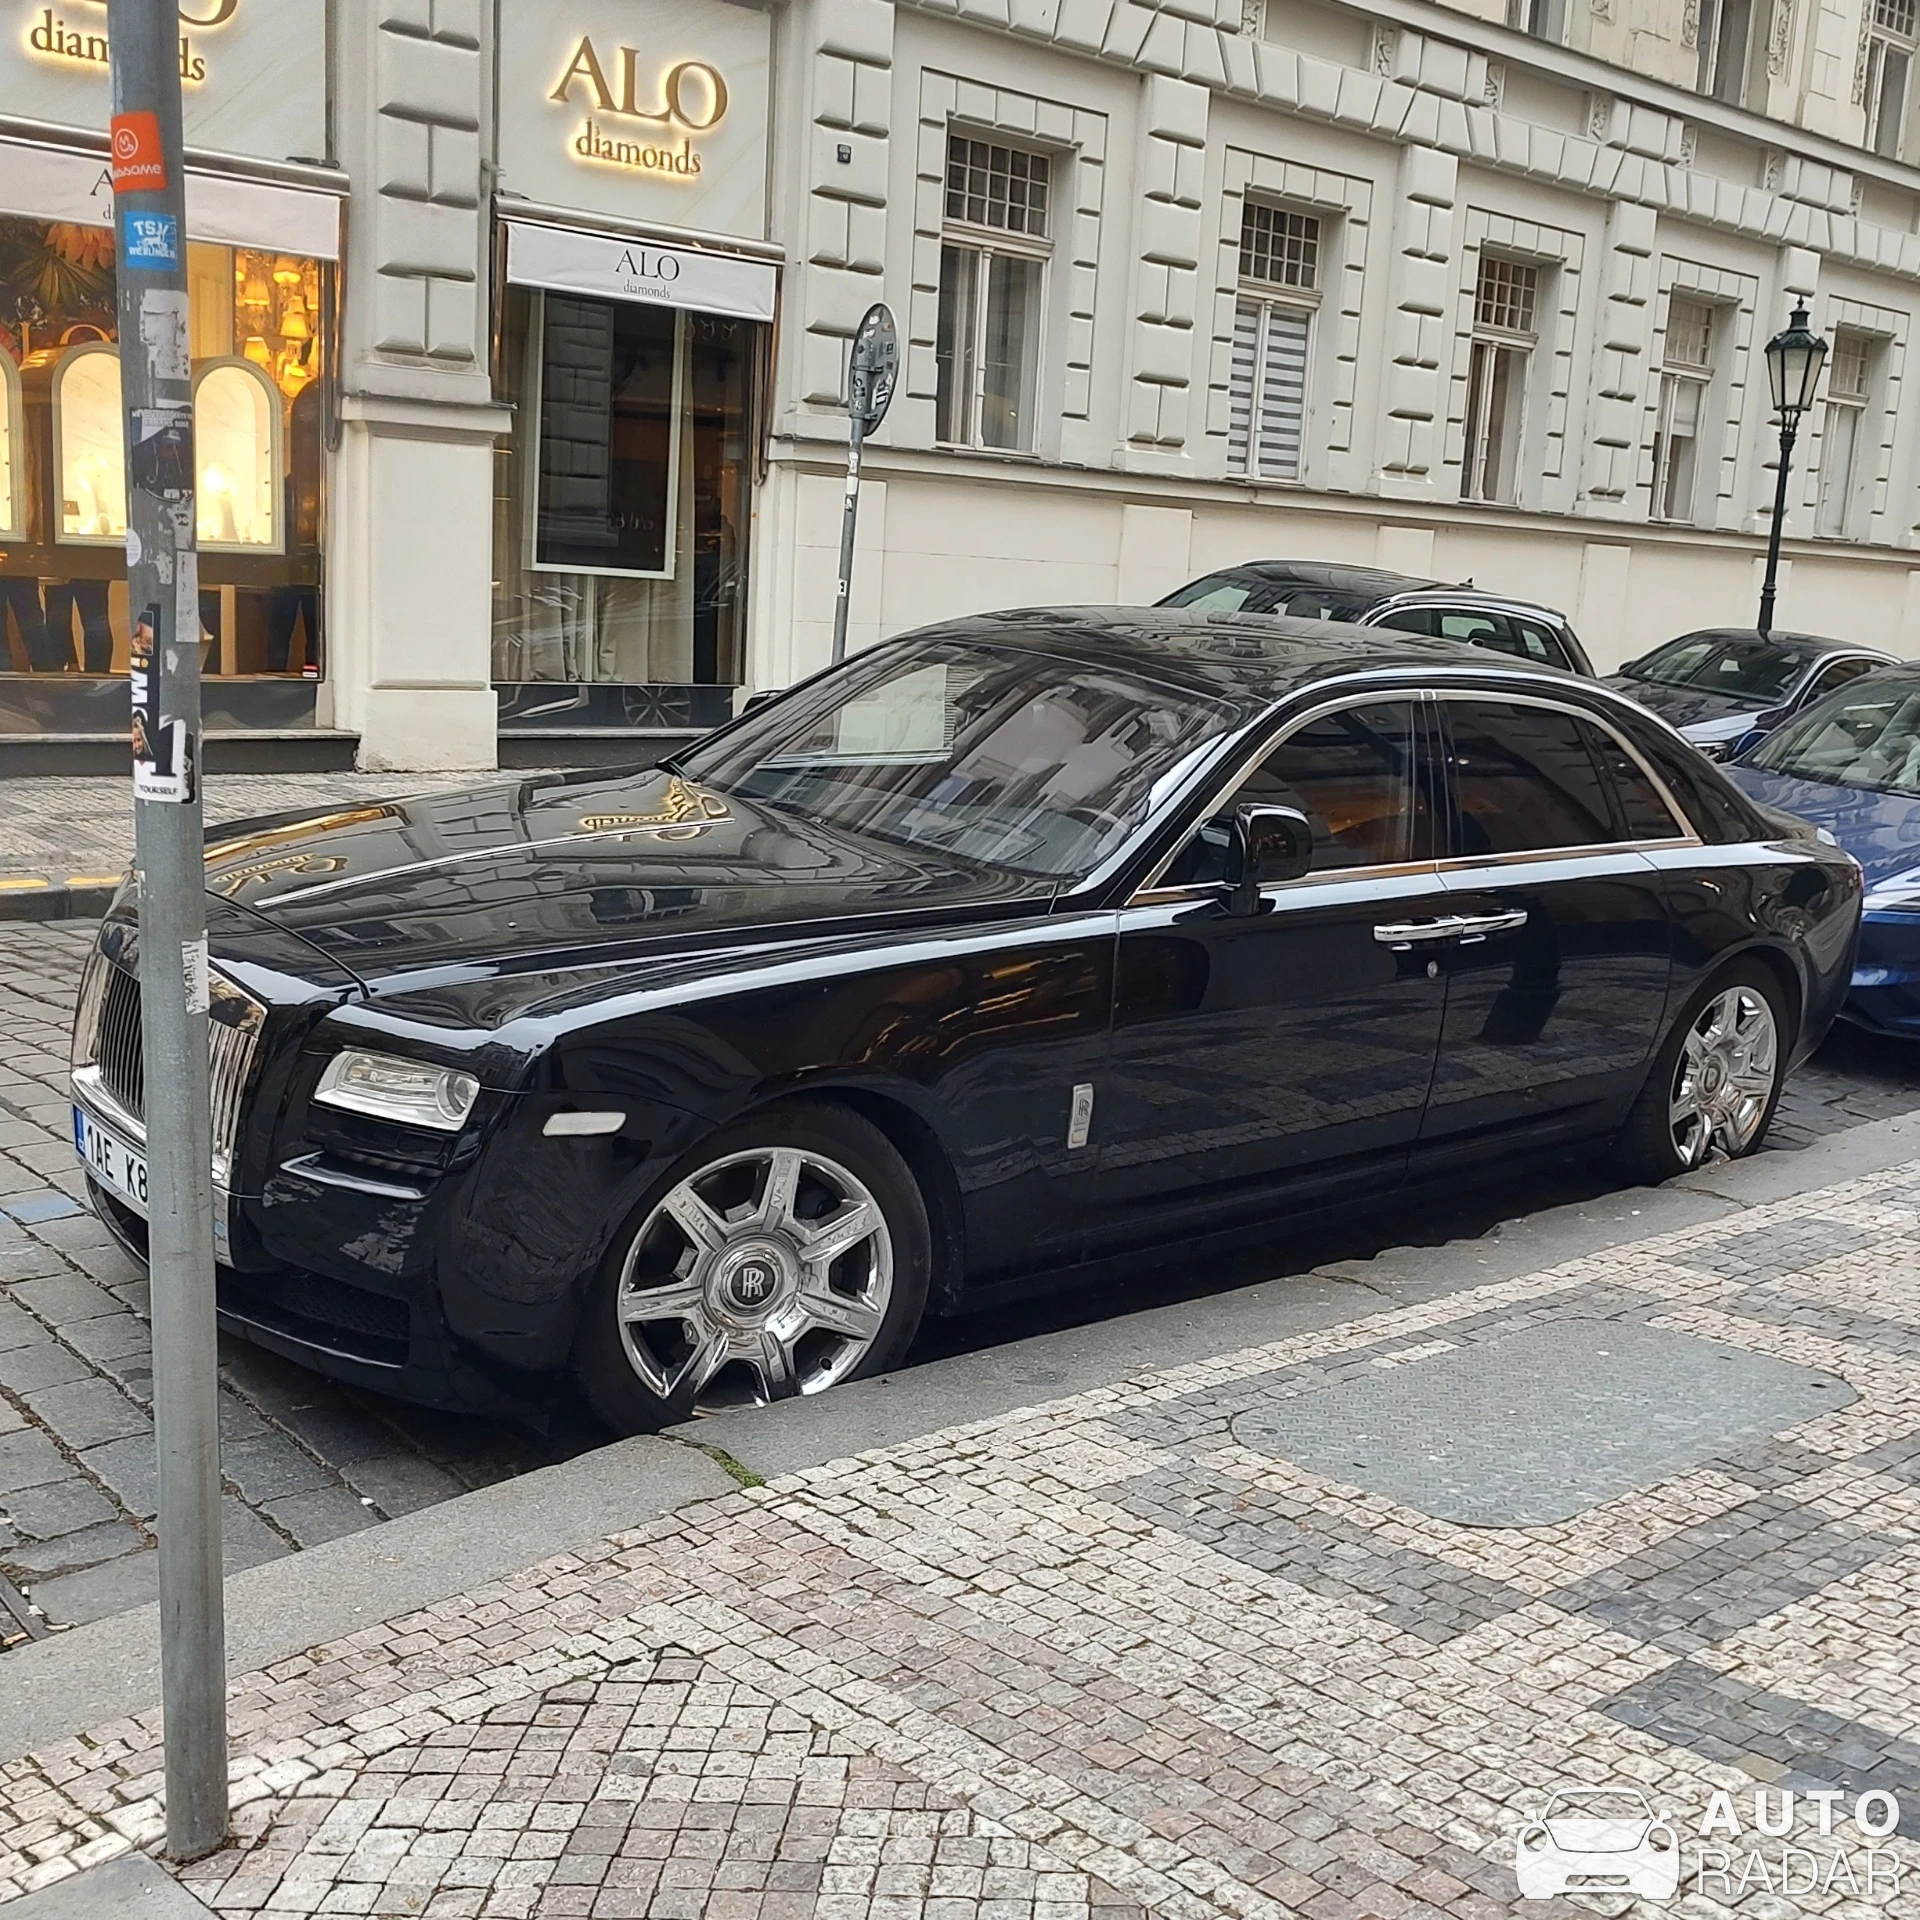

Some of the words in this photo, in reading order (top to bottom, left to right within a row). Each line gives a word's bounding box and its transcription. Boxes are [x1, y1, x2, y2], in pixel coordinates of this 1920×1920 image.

[30, 9, 206, 81] diamds
[549, 35, 728, 131] ALO
[575, 117, 701, 175] diamonds
[615, 249, 680, 282] ALO
[623, 279, 671, 299] diamonds
[87, 1124, 115, 1180] 1AE
[741, 1267, 765, 1299] RR
